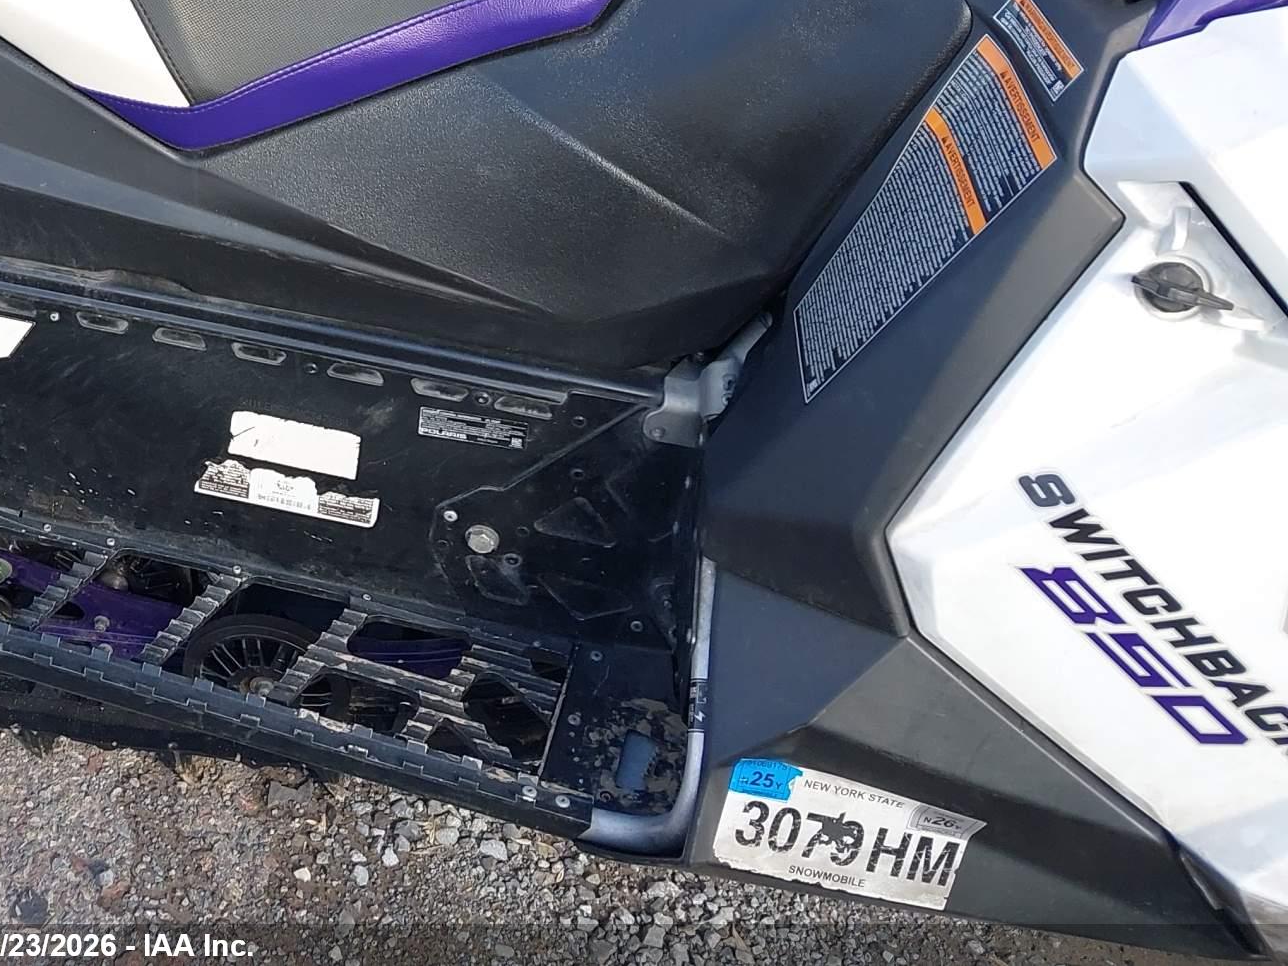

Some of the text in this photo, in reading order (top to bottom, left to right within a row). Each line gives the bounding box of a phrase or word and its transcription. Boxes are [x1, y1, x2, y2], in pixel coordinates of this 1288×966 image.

[1004, 72, 1041, 142] AVERTISSEMENT
[945, 139, 975, 207] AVERTISSEMENT
[1018, 474, 1288, 746] SWITCHBAC
[1020, 567, 1249, 745] 850
[804, 779, 906, 809] NEW YORK STATE
[788, 865, 865, 887] SNOWMOBILE
